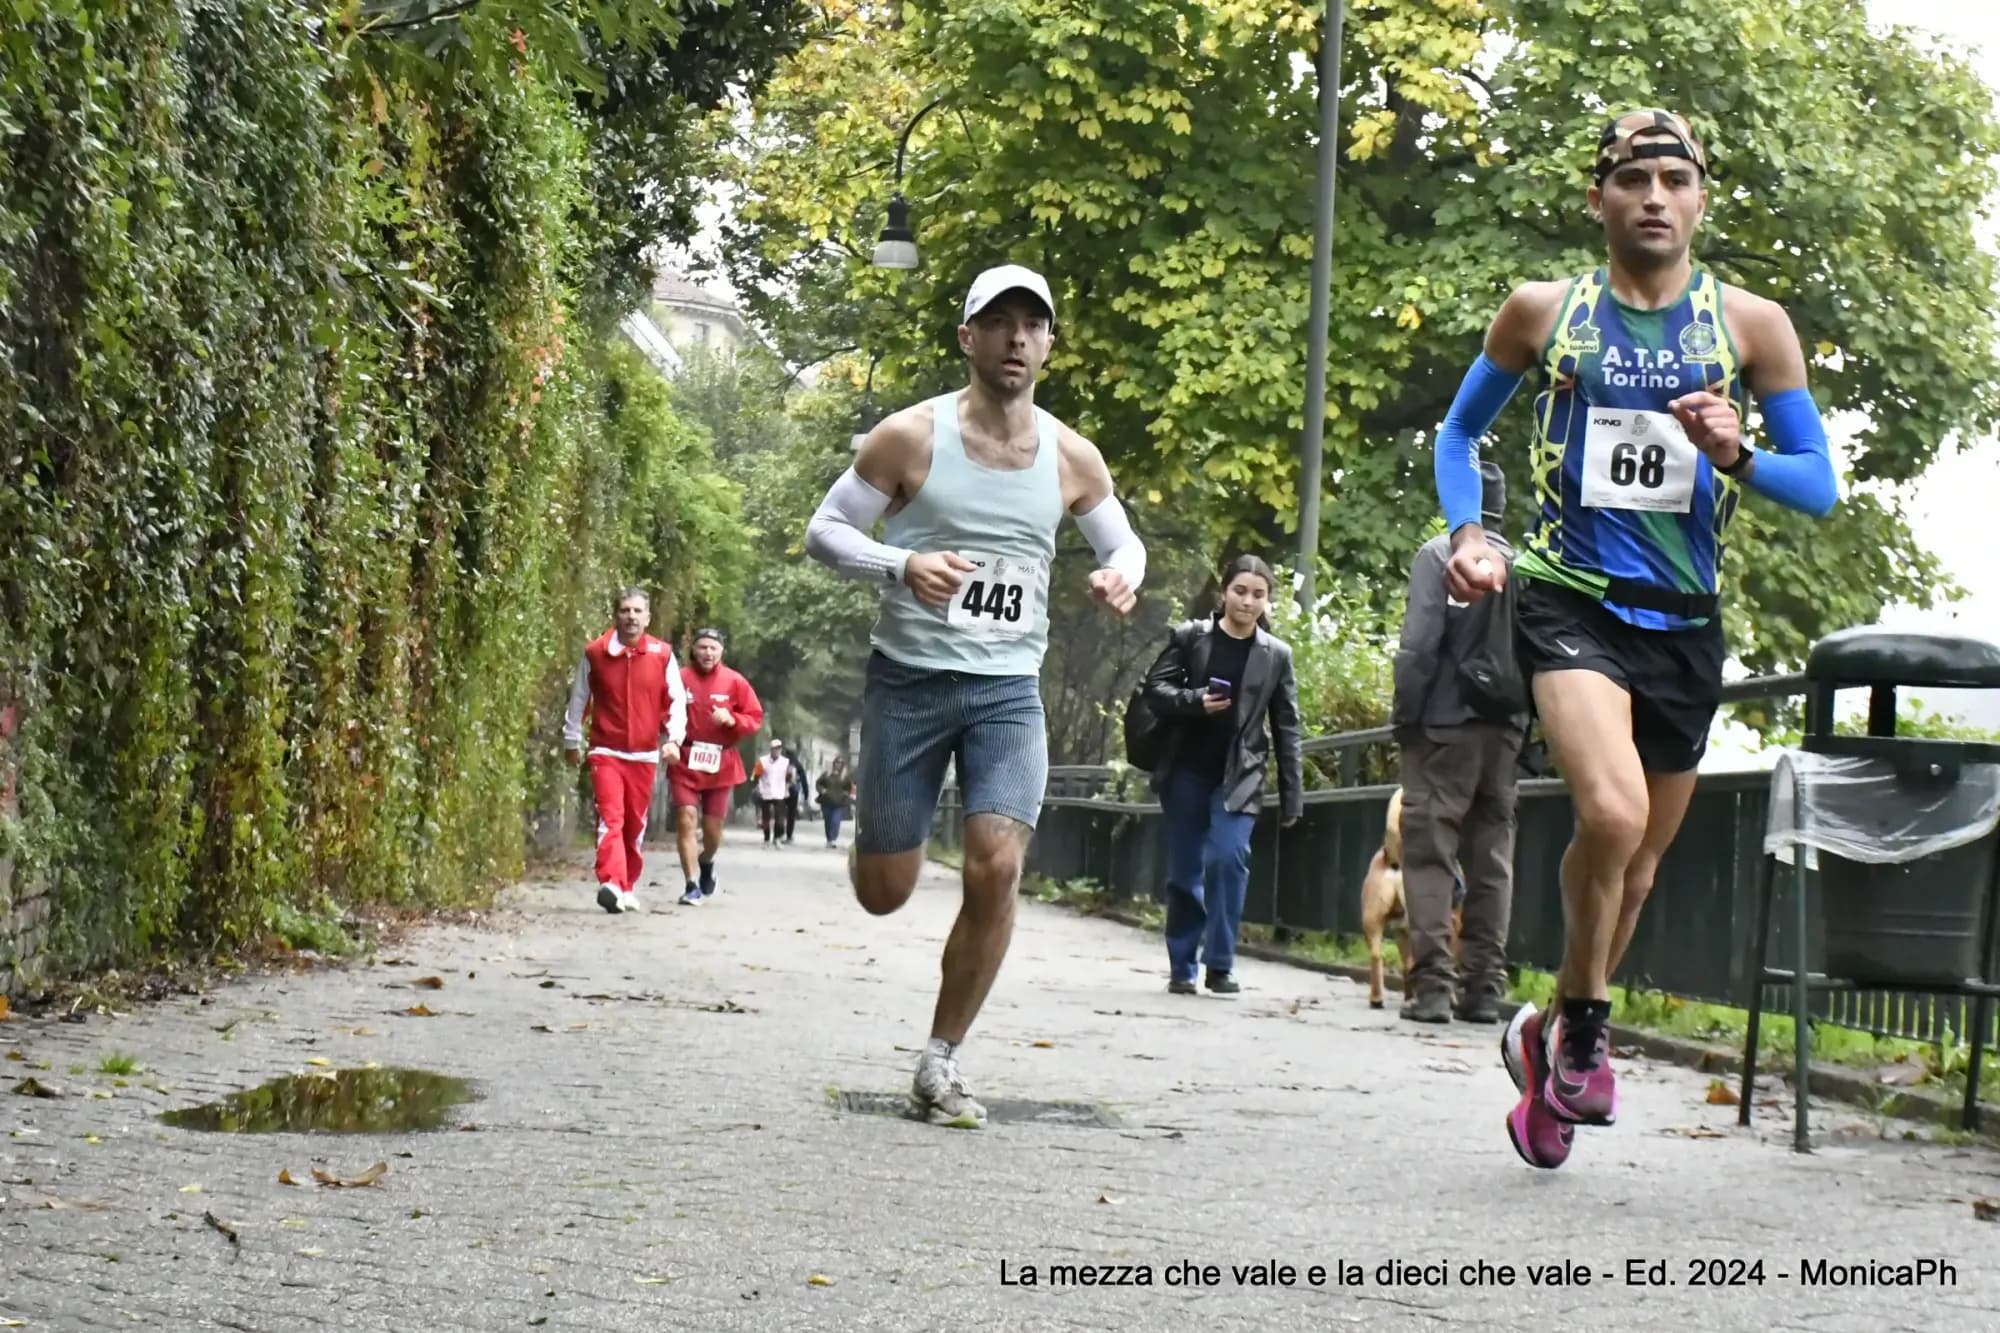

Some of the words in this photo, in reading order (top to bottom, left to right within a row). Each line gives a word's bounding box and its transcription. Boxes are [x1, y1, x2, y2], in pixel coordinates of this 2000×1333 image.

[1601, 345, 1680, 370] A.T.P.
[1601, 366, 1680, 389] Torino
[1593, 418, 1622, 427] KING
[1610, 442, 1667, 489] 68
[961, 580, 1024, 623] 443
